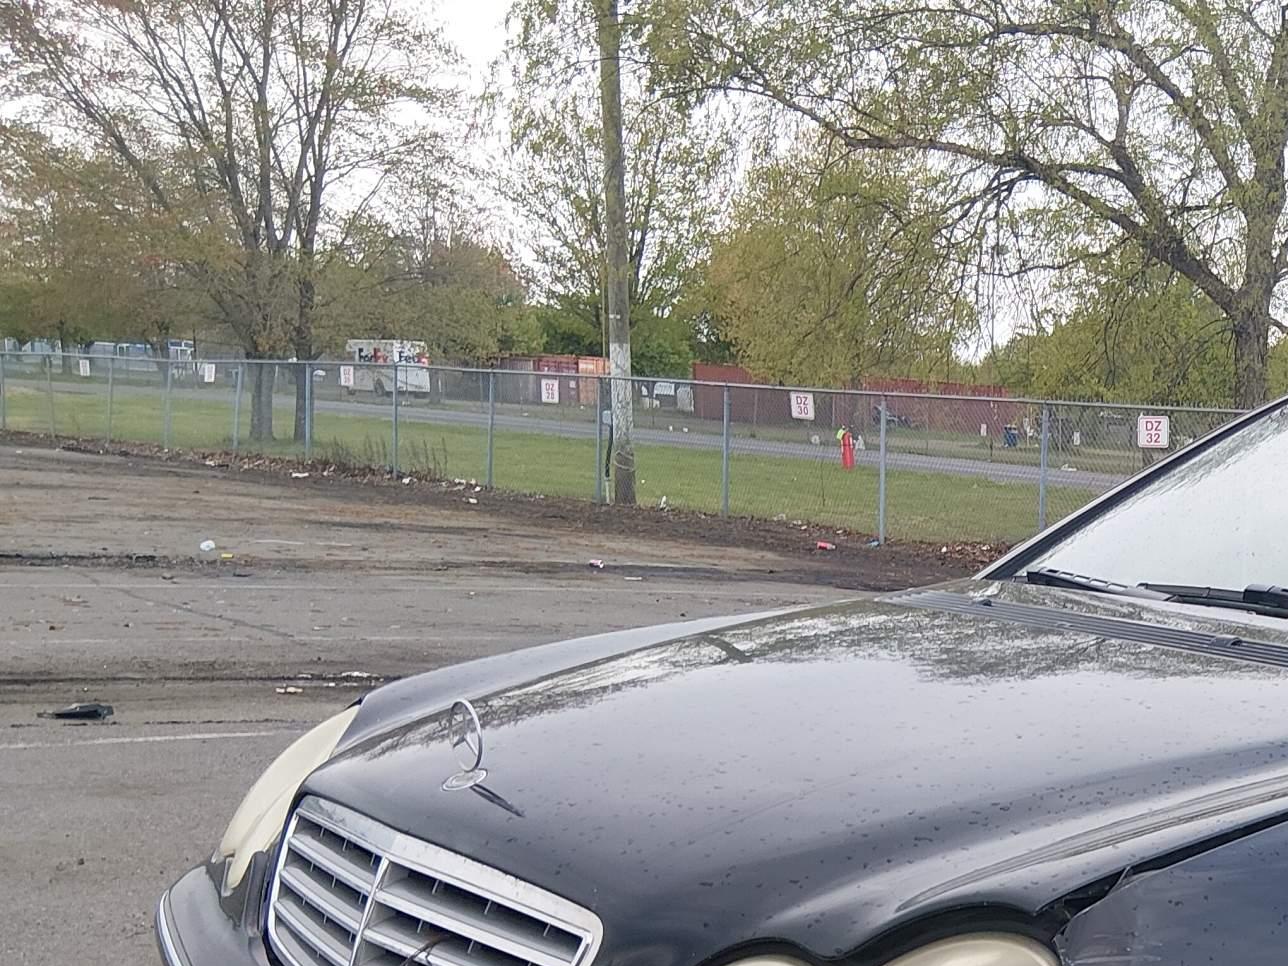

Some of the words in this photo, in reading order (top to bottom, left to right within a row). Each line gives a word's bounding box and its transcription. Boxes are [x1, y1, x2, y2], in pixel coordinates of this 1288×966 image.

[545, 382, 555, 391] DZ
[796, 396, 809, 405] DZ
[797, 405, 809, 415] 30
[1145, 420, 1162, 431] DZ
[1146, 432, 1161, 444] 32
